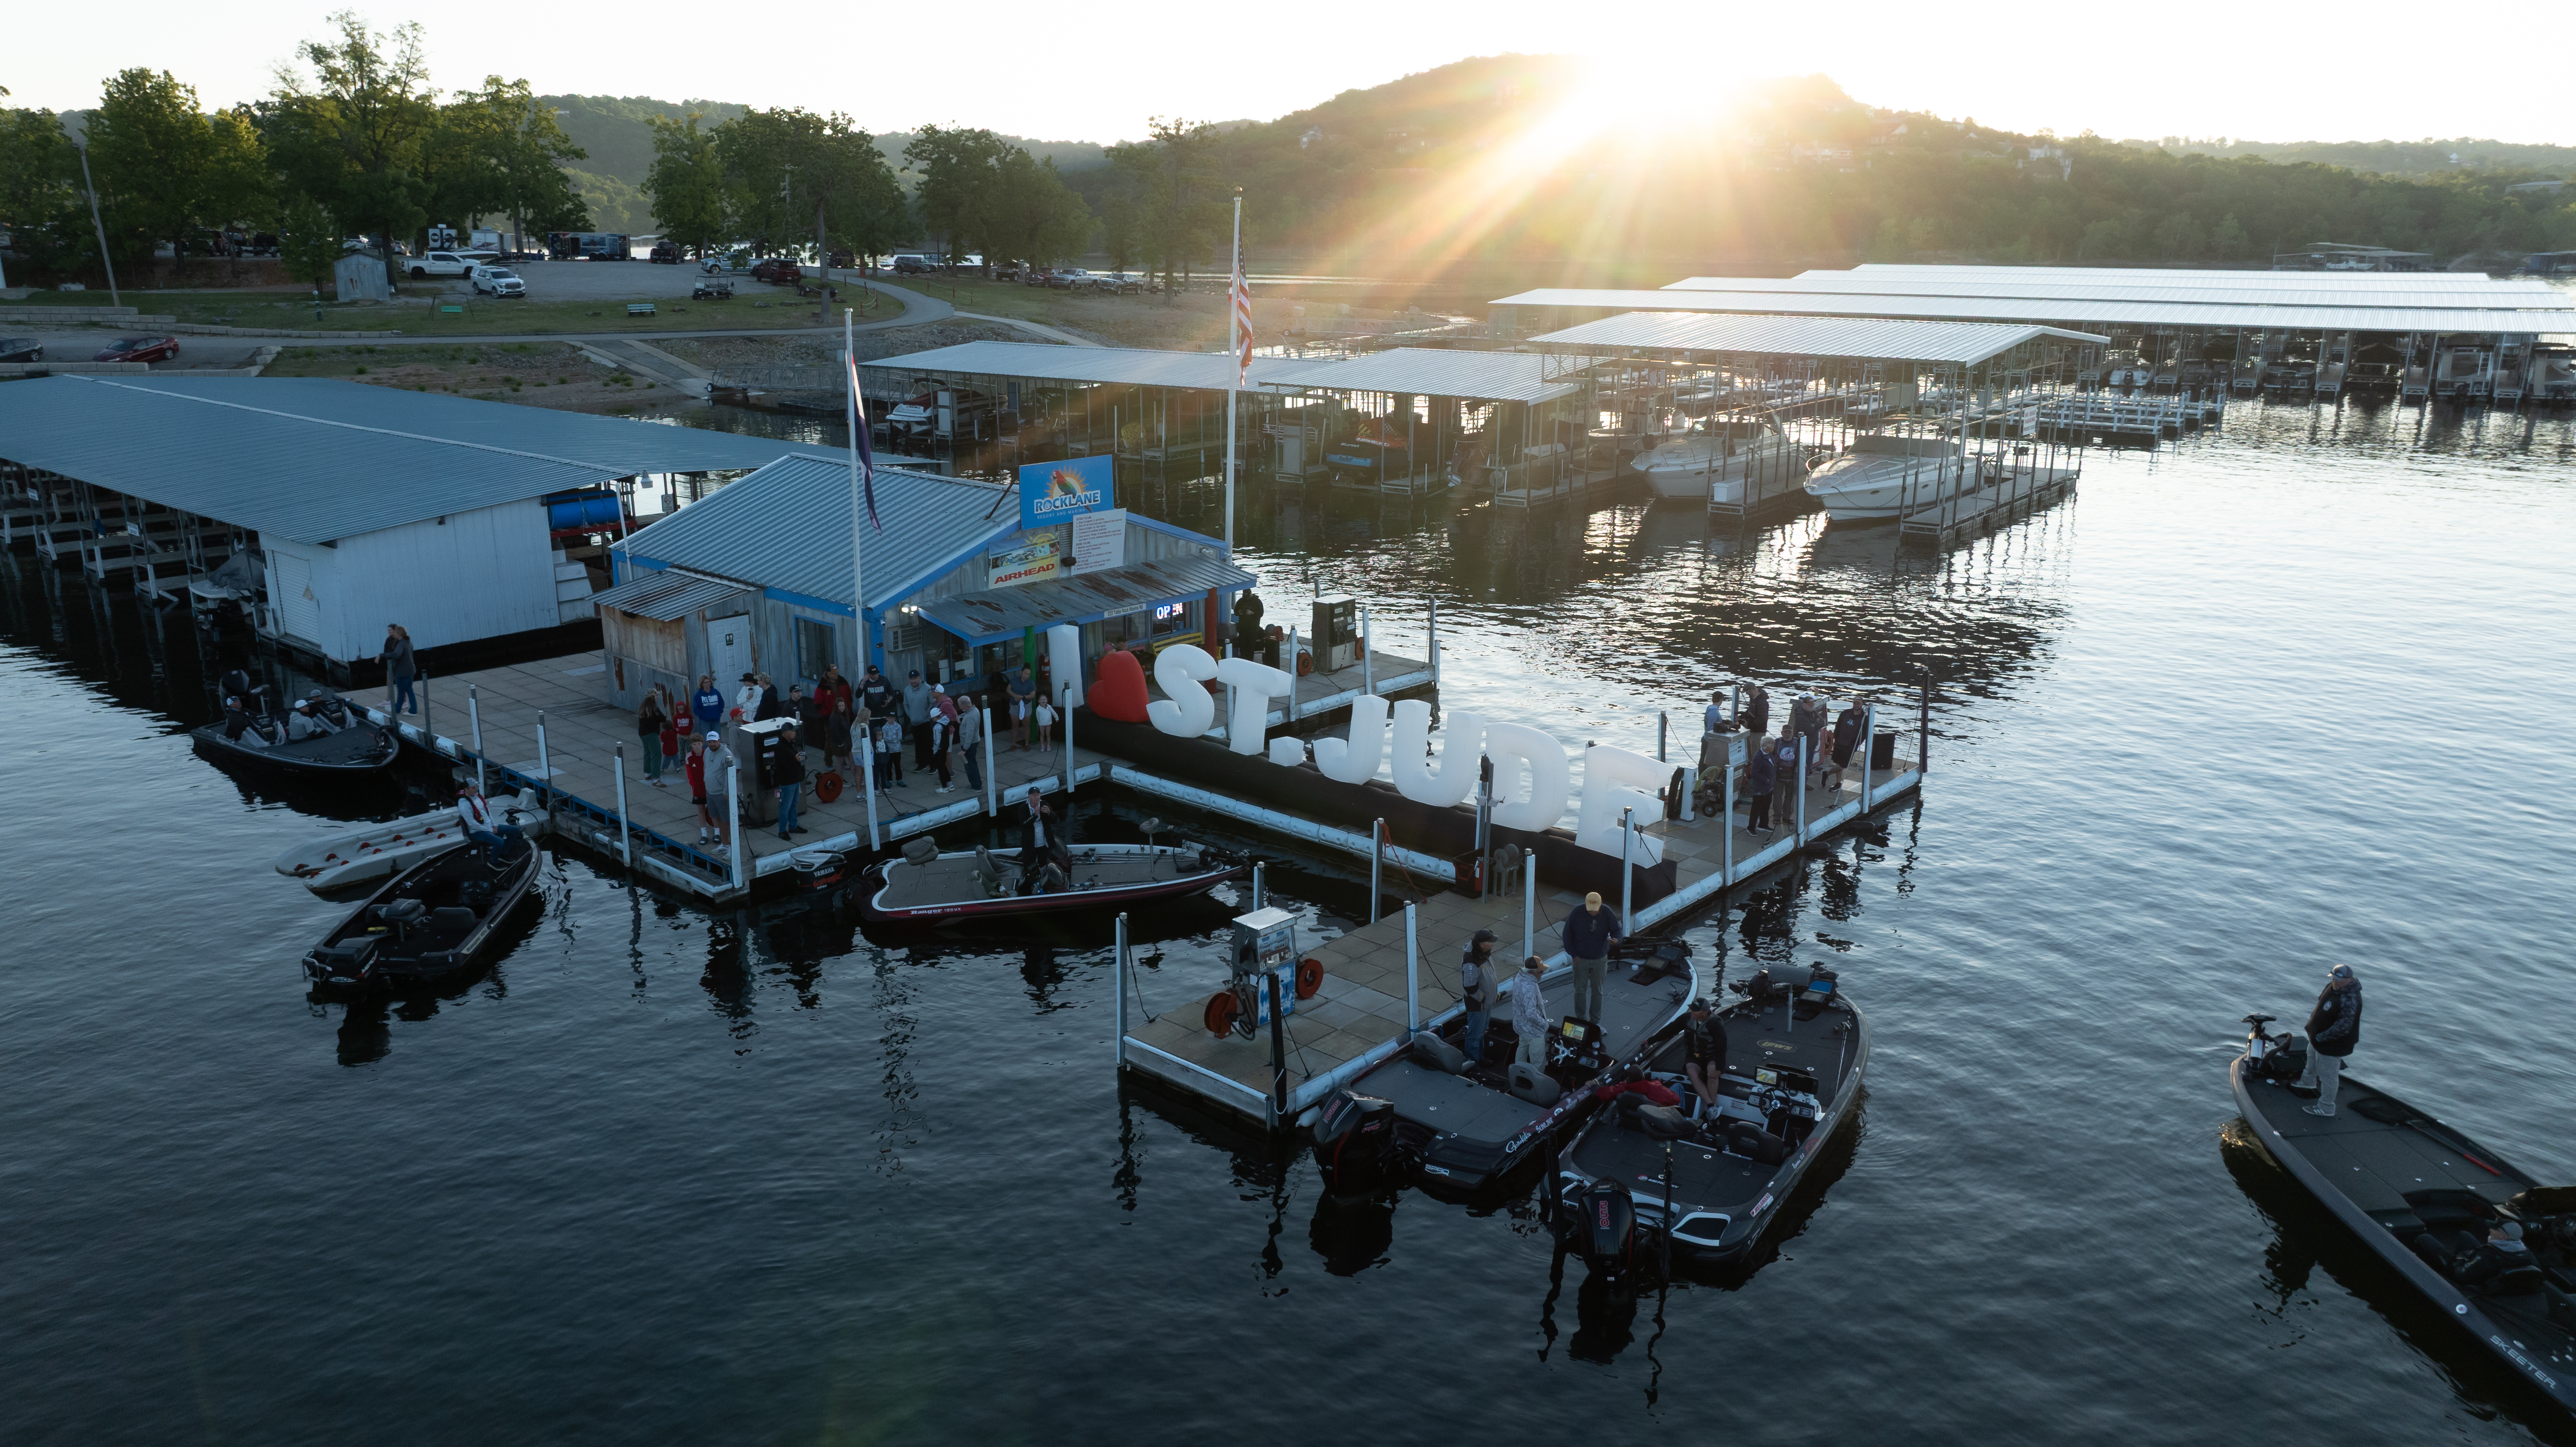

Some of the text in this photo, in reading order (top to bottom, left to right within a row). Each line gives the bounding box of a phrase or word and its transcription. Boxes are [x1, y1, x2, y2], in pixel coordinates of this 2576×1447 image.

[1035, 491, 1099, 512] ROCKLANE
[994, 563, 1054, 584] AIRHEAD
[1157, 603, 1182, 619] OPEN
[1313, 694, 1672, 869] JUDE
[814, 867, 835, 877] YAMAHA
[1324, 1099, 1341, 1121] 250
[1361, 1123, 1381, 1133] PRO
[1535, 1117, 1554, 1133] SUNLINE
[1425, 1164, 1450, 1174] SPRO
[1754, 1192, 1771, 1213] MEGAWARE
[1599, 1201, 1610, 1227] 250
[2490, 1335, 2556, 1389] SKEETER
